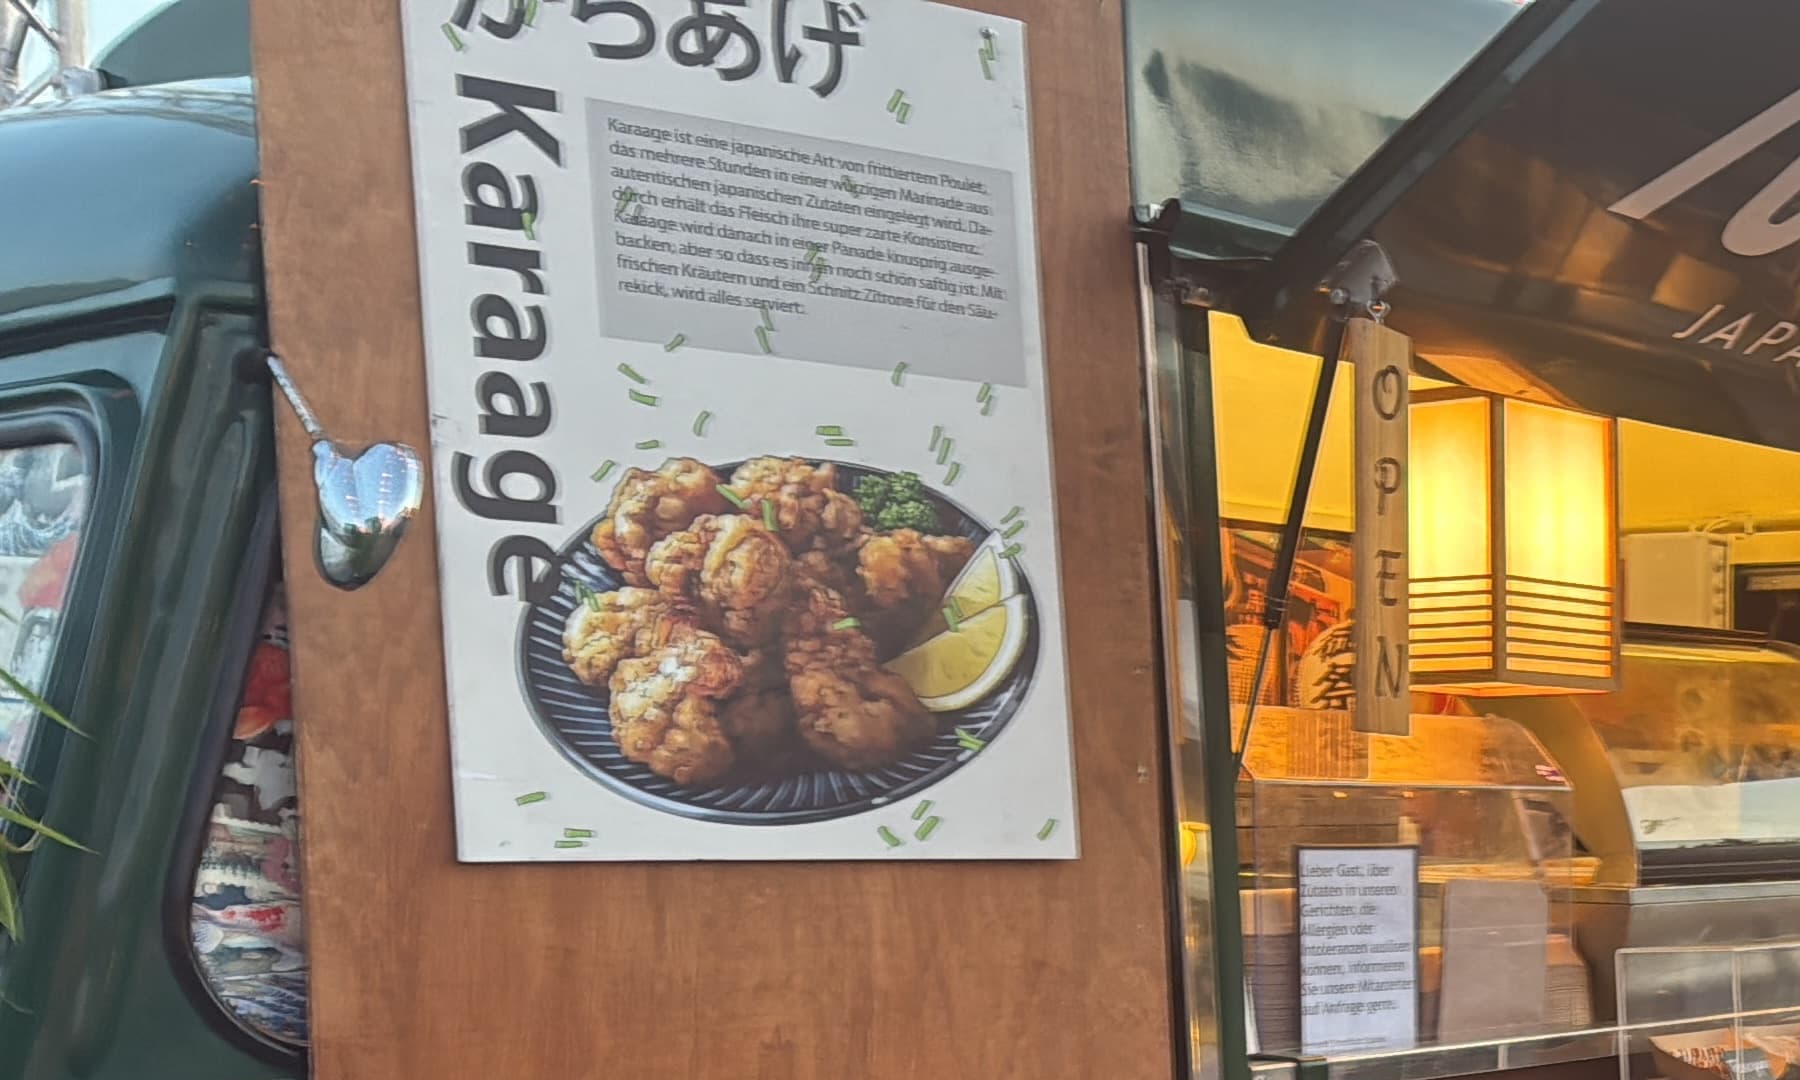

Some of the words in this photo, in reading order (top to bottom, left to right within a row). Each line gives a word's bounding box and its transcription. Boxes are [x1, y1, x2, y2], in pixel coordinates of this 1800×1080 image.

[608, 117, 672, 144] Karaage
[674, 128, 692, 145] ist
[694, 132, 728, 150] eine
[729, 138, 811, 167] japanische
[813, 152, 835, 168] Art
[838, 159, 864, 173] von
[867, 161, 938, 186] frittiertem
[609, 140, 635, 157] das
[639, 145, 705, 168] mehrere
[708, 156, 771, 179] Stunden
[773, 167, 788, 182] in
[790, 170, 828, 188] einer
[899, 188, 963, 210] Marinade
[965, 202, 989, 214] aus
[610, 162, 710, 192] autentischen
[713, 179, 802, 209] japanischen
[805, 194, 860, 215] Zutaten
[863, 203, 930, 229] eingelegt
[931, 214, 965, 232] wird.
[968, 220, 992, 236] Da-
[710, 200, 734, 217] das
[738, 205, 788, 226] Fleisch
[791, 213, 820, 230] ihre
[822, 218, 862, 240] super
[865, 224, 900, 243] zarte
[677, 240, 713, 258] aber
[716, 249, 733, 261] so
[736, 249, 768, 266] dass
[772, 257, 788, 269] es
[836, 263, 871, 280] noch
[874, 269, 916, 287] schön
[919, 275, 956, 295] saftig
[980, 284, 1003, 299] Mit
[680, 218, 713, 236] wird
[716, 223, 771, 245] danach
[774, 232, 789, 247] in
[792, 234, 828, 253] einer
[831, 240, 884, 261] Panade
[887, 249, 947, 273] knusprig
[616, 254, 678, 276] frischen
[681, 263, 746, 285] Kräutern
[749, 272, 779, 289] und
[778, 276, 805, 293] ein
[807, 280, 860, 300] Schnitz
[862, 288, 914, 308] Zitrone
[914, 295, 936, 311] für
[938, 299, 965, 315] den
[967, 303, 998, 319] Säu-
[671, 284, 705, 301] wird
[708, 289, 742, 306] alles
[452, 73, 565, 606] Karaage
[1372, 365, 1405, 698] OPEN
